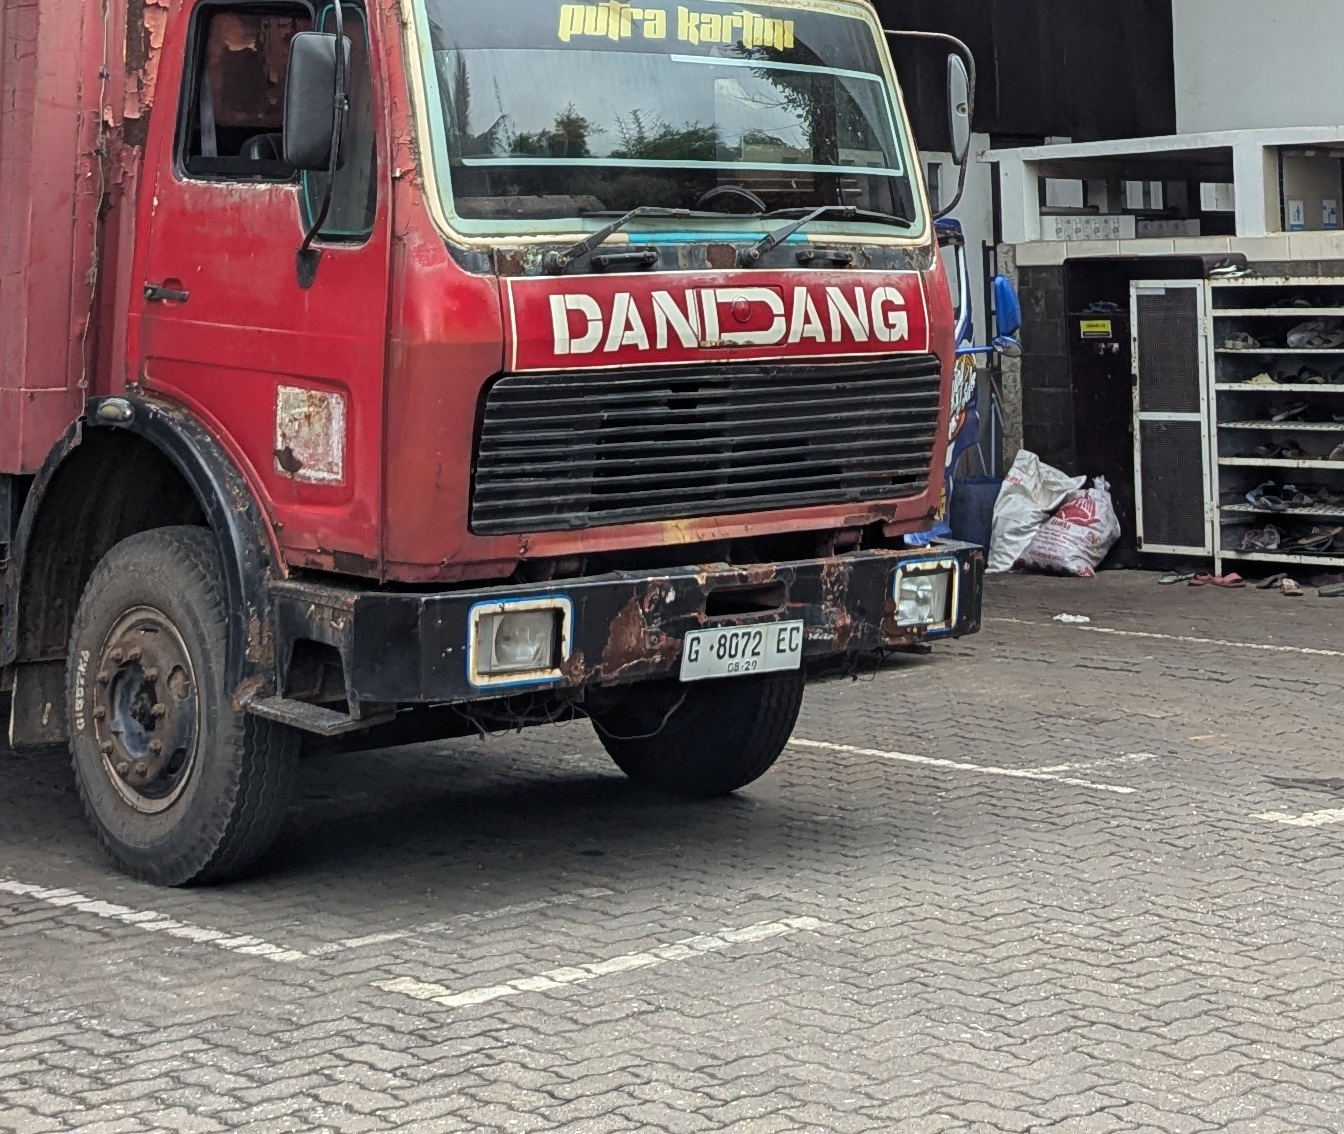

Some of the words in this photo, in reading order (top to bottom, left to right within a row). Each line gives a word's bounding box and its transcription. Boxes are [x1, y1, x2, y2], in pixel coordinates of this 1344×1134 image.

[557, 0, 666, 42] putra
[677, 5, 795, 52] kartini
[548, 286, 909, 355] DANDANG
[687, 636, 701, 663] G
[716, 630, 763, 660] 8072
[776, 626, 801, 654] EC
